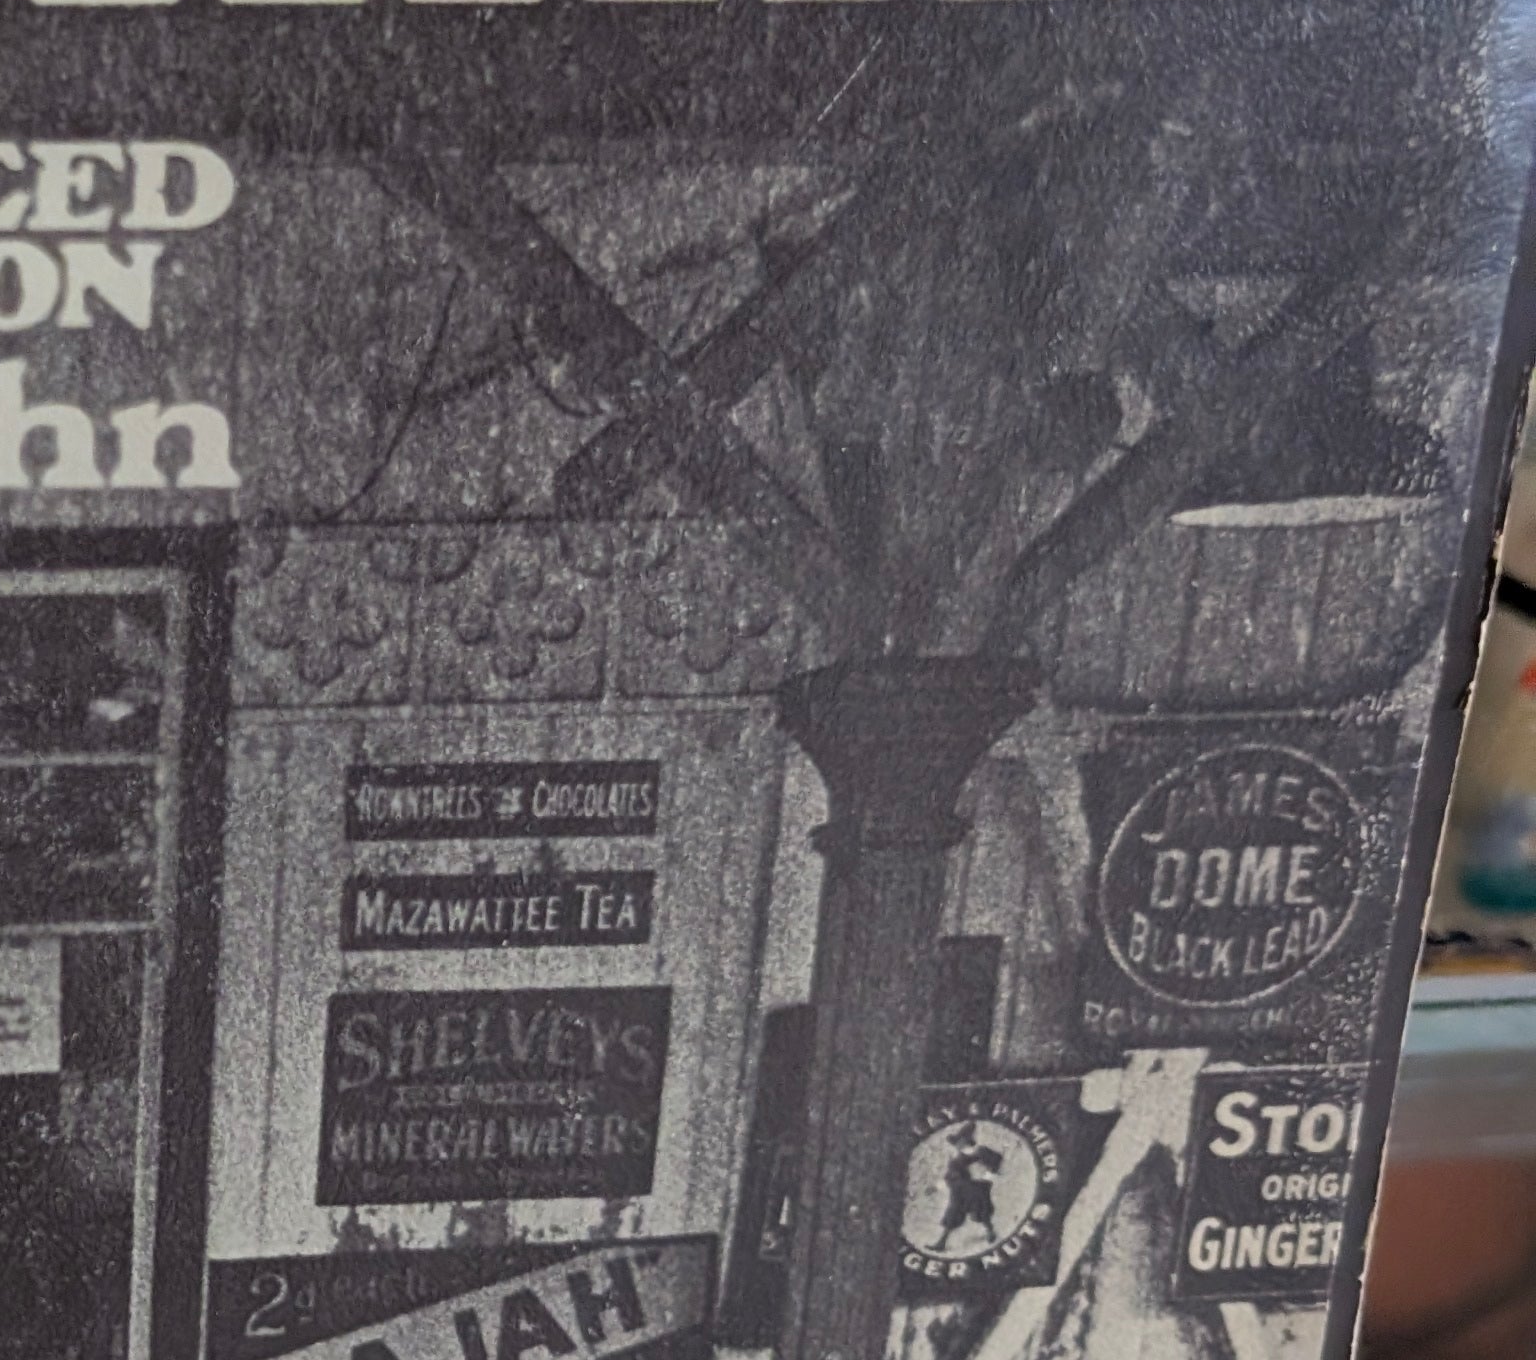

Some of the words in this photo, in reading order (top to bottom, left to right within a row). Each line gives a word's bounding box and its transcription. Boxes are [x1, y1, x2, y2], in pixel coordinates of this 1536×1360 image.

[531, 780, 653, 819] CHOCOLATES
[1149, 844, 1323, 910] DOME
[354, 888, 563, 937] MAZAWATTEE
[574, 883, 638, 932] TEA
[1127, 910, 1234, 980] BLACK
[1242, 904, 1330, 976] LEAD
[506, 1112, 652, 1159] WATERS
[1188, 1216, 1344, 1272] GINGER
